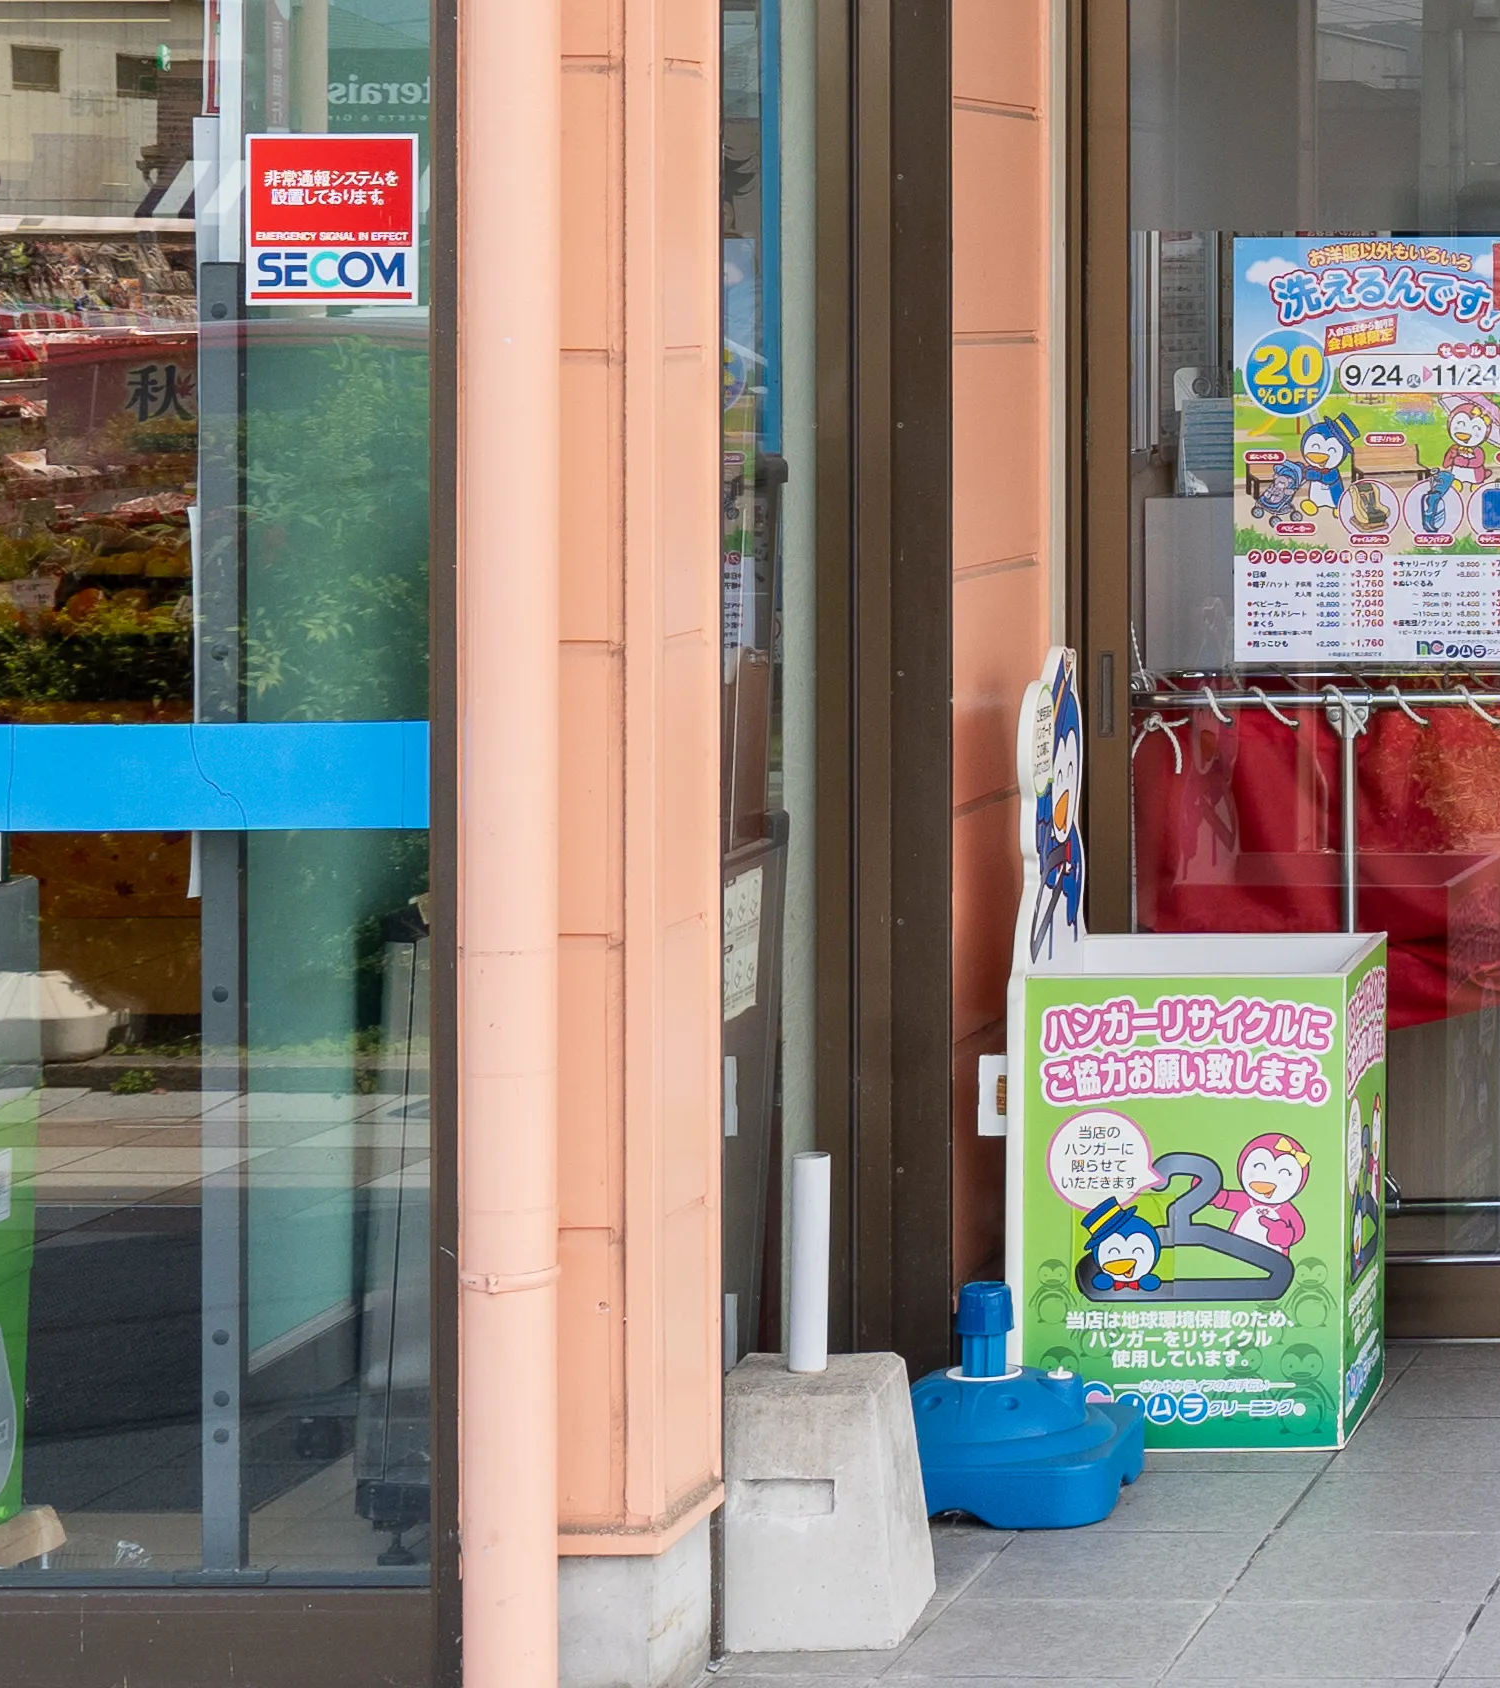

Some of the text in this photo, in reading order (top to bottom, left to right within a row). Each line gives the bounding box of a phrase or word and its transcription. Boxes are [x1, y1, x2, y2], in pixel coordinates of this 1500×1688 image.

[264, 170, 399, 187] 非常通報システムを
[271, 188, 384, 205] 設置しております。
[255, 231, 409, 241] EMERGENCY SIGNAL IN EFFECT
[1307, 241, 1474, 272] お洋服以外もいろいろ
[258, 251, 405, 288] SECOM
[1327, 327, 1394, 350] 会員様限定
[1254, 344, 1324, 387] 20
[1345, 365, 1499, 387] 9/24 11/24
[1257, 388, 1319, 406] %OFF
[1043, 998, 1333, 1051] ハンガーリサイクルに
[1044, 1055, 1329, 1102] ご協力お願い致します。
[1079, 1126, 1120, 1139] 当店の
[1065, 1143, 1134, 1155] ハンガーに
[1072, 1160, 1126, 1172] 限らせて
[1062, 1177, 1137, 1189] いただきます
[1065, 1309, 1295, 1330] 当店は地球環境保護のため、
[1089, 1330, 1272, 1349] ハンガーをリサイクル
[1112, 1349, 1250, 1369] 使用しています。
